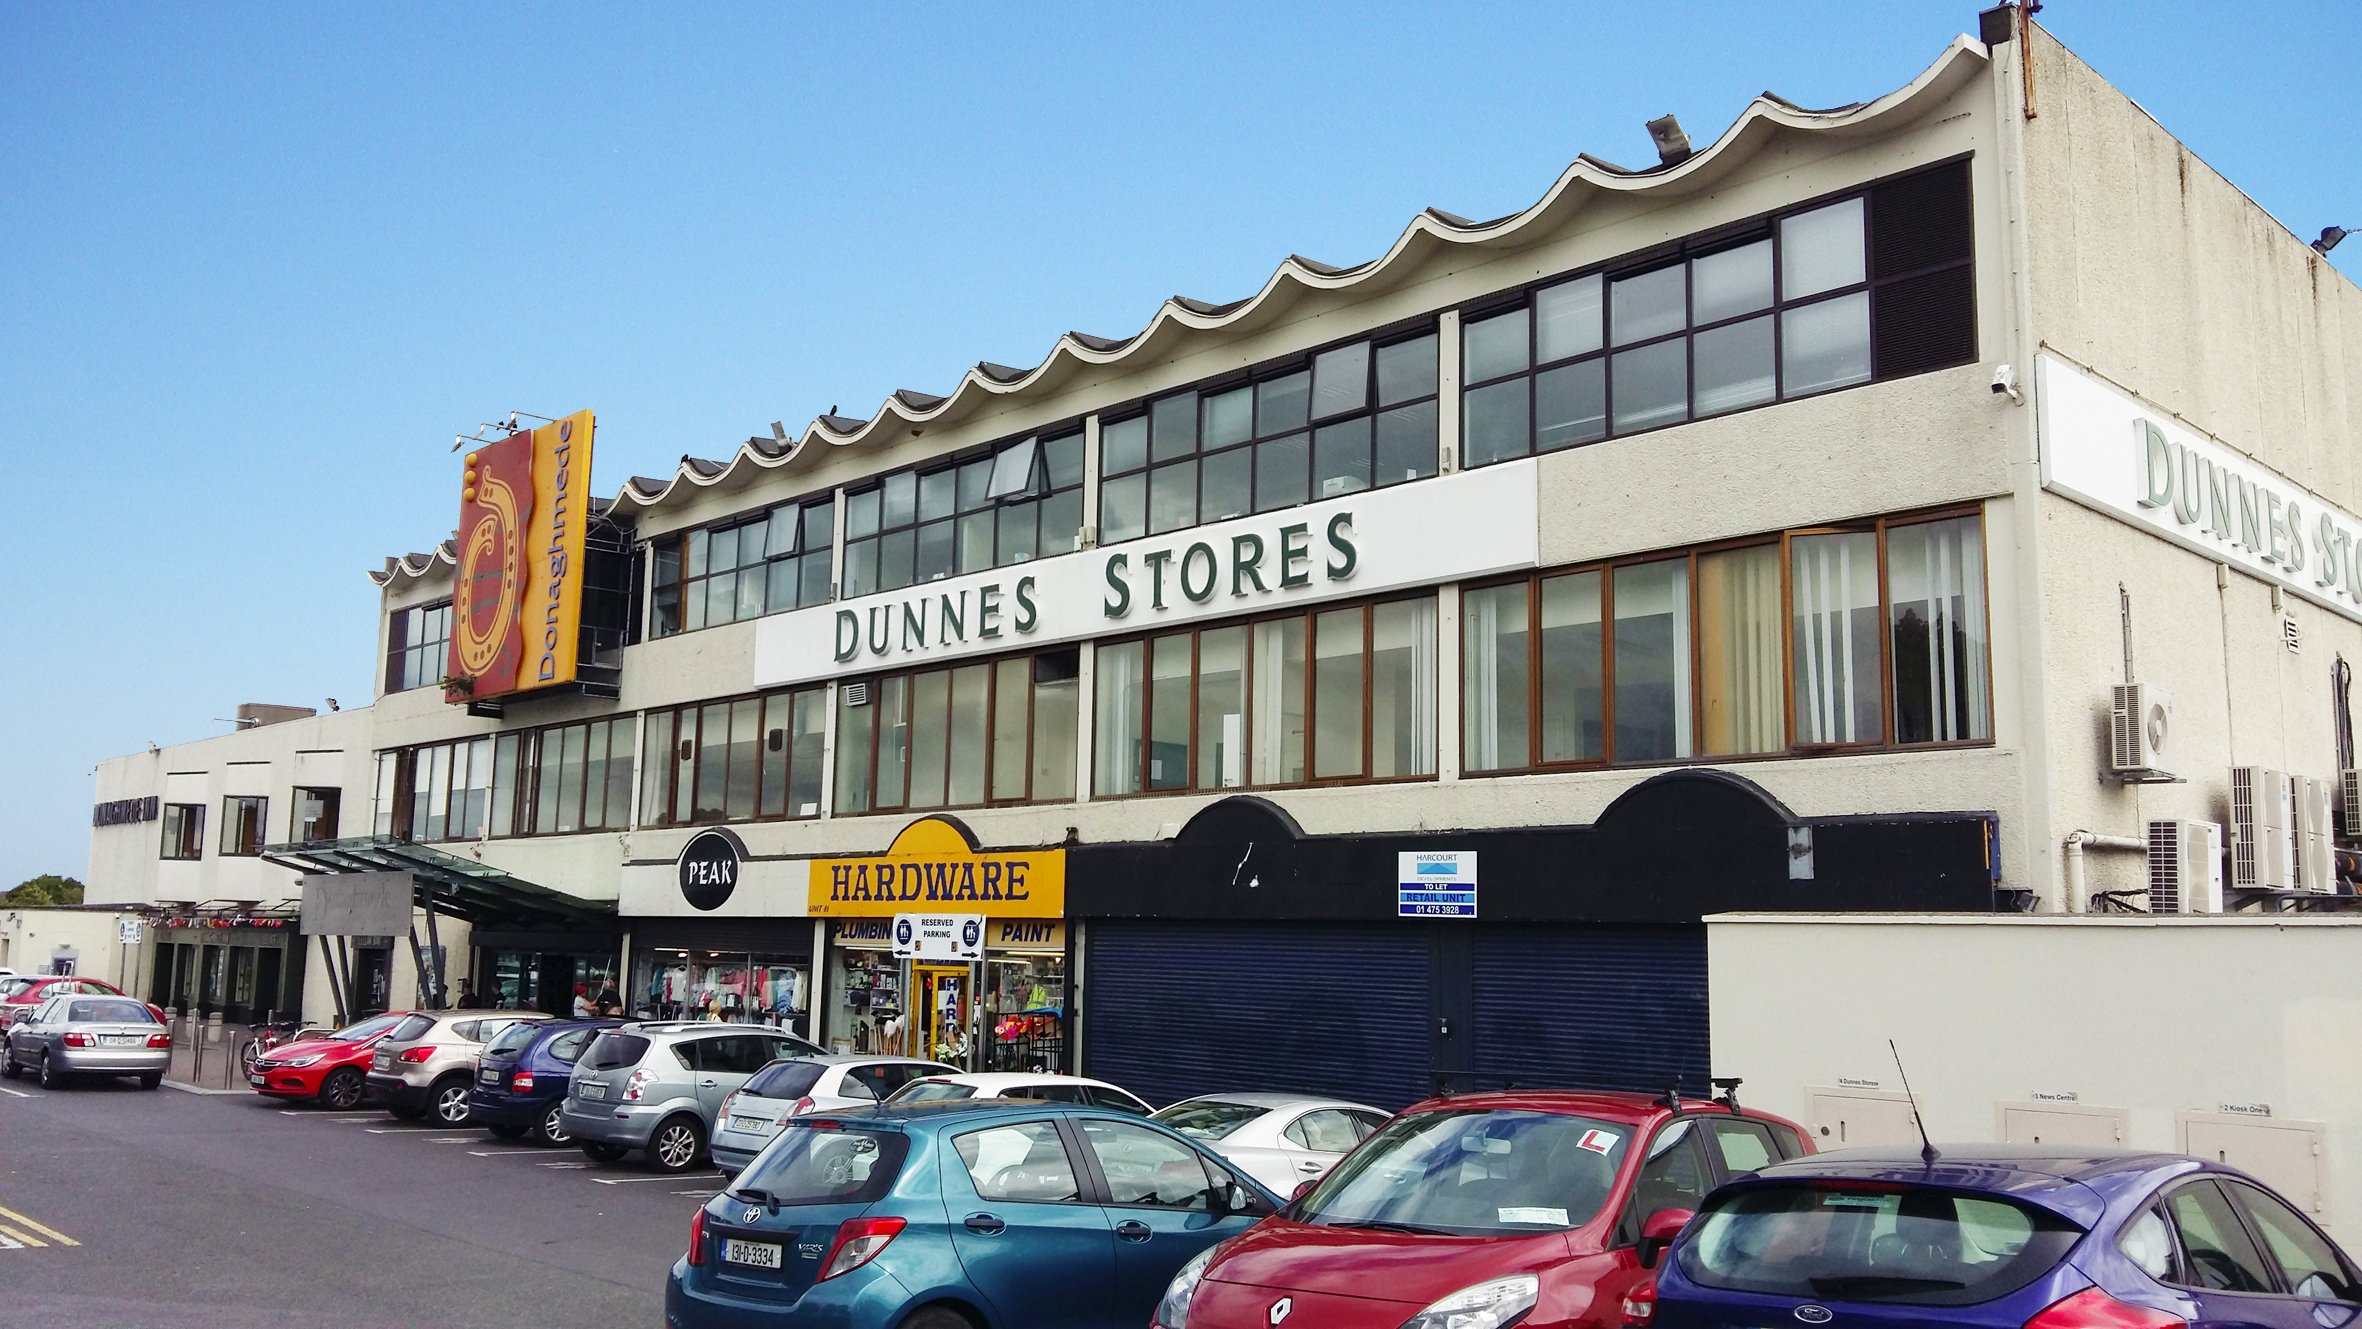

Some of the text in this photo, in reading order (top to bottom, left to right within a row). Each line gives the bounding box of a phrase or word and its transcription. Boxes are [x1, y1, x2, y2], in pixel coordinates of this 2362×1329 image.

[2134, 417, 2305, 573] DUNNES
[538, 419, 573, 683] Donaghmede
[834, 512, 1357, 662] DUNNES STORES
[688, 860, 732, 885] PEAK
[830, 861, 1030, 901] HARDWARE
[1406, 893, 1466, 903] RETAIL UNIT
[1416, 905, 1460, 914] 01 475 3928
[833, 921, 893, 940] PLUMBIN
[921, 918, 954, 926] RESERVED
[923, 930, 951, 938] PARKING
[1001, 923, 1056, 942] PAINT
[2230, 1104, 2248, 1112] Kiosk
[1581, 1130, 1606, 1152] L
